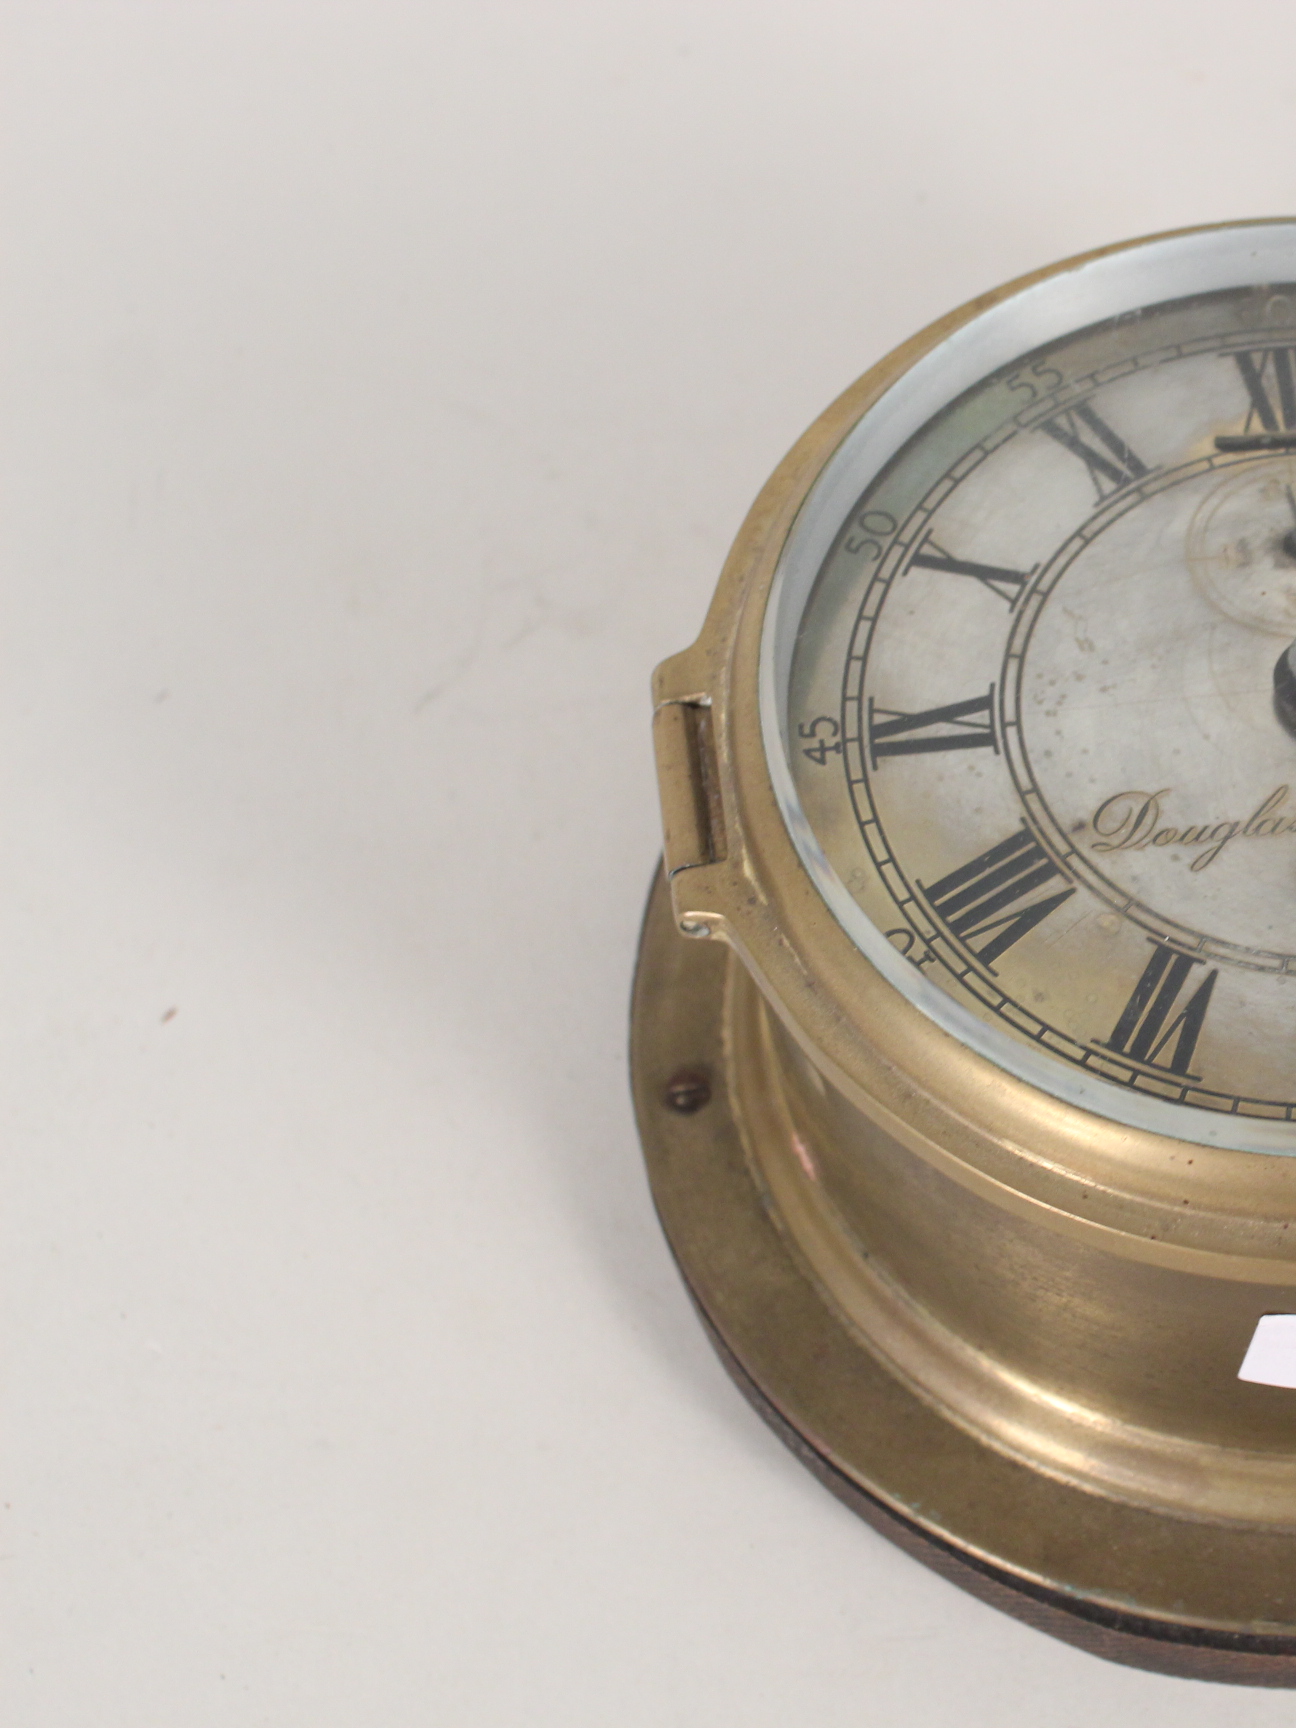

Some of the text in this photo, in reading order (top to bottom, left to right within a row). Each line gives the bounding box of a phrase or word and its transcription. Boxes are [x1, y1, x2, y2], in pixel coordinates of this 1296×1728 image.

[1006, 360, 1064, 400] 55
[1033, 400, 1164, 507] XI
[845, 510, 899, 562] 50
[902, 528, 1041, 613] X
[799, 716, 843, 767] 45
